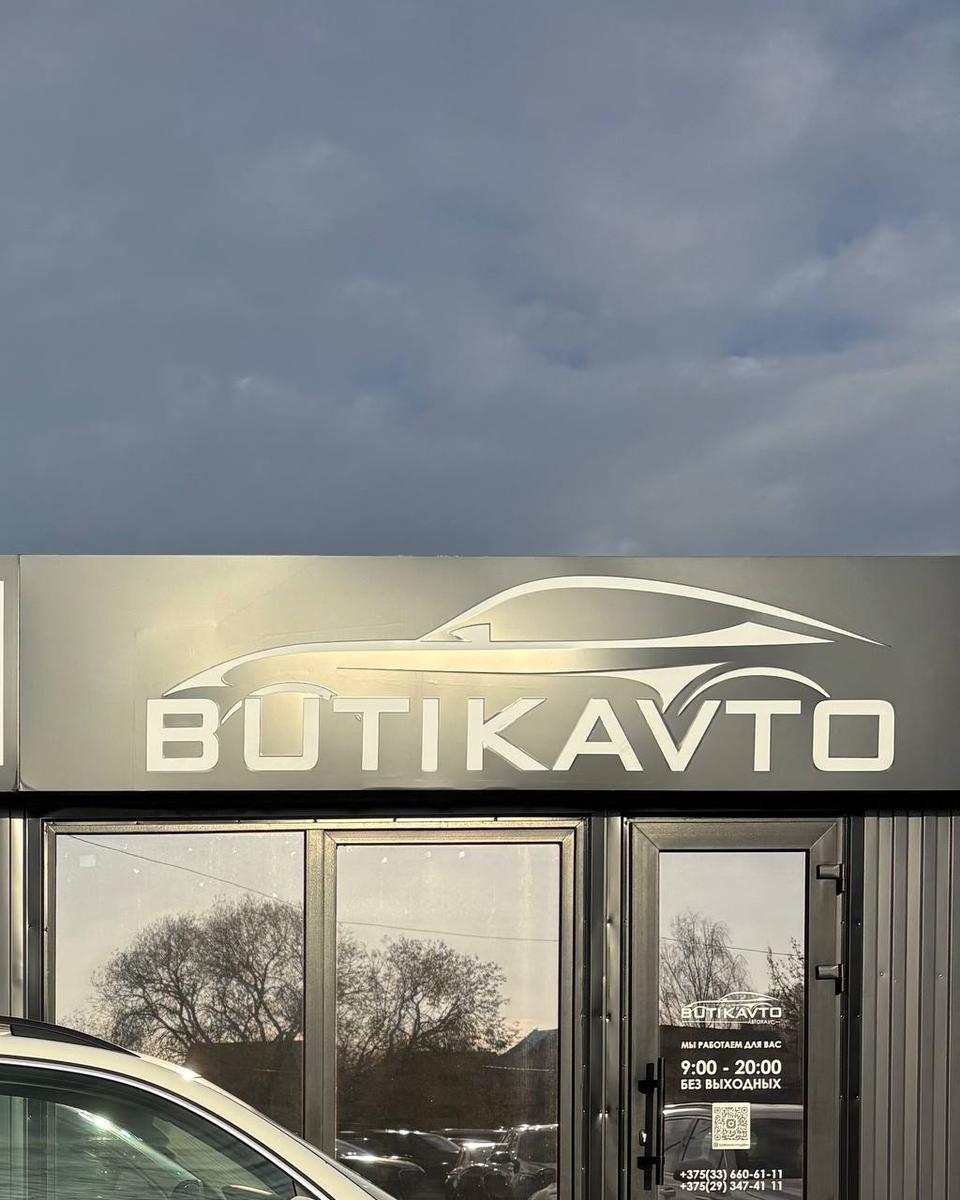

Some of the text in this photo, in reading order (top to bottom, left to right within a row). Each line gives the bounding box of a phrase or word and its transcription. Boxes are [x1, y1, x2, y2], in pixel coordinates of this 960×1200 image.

[146, 698, 895, 771] BUTIKAVTO
[681, 1007, 782, 1018] BUTIKAVTO
[681, 1041, 782, 1050] МЫ РАБОТАЕМ ДЛЯ ВАС
[681, 1060, 717, 1075] 9:00
[735, 1060, 782, 1075] 20:00
[681, 1079, 782, 1091] БЕЗ ВЫХОДНЫХ
[680, 1169, 783, 1181] +375(33) 660-61-11
[680, 1181, 727, 1193] +375(29)
